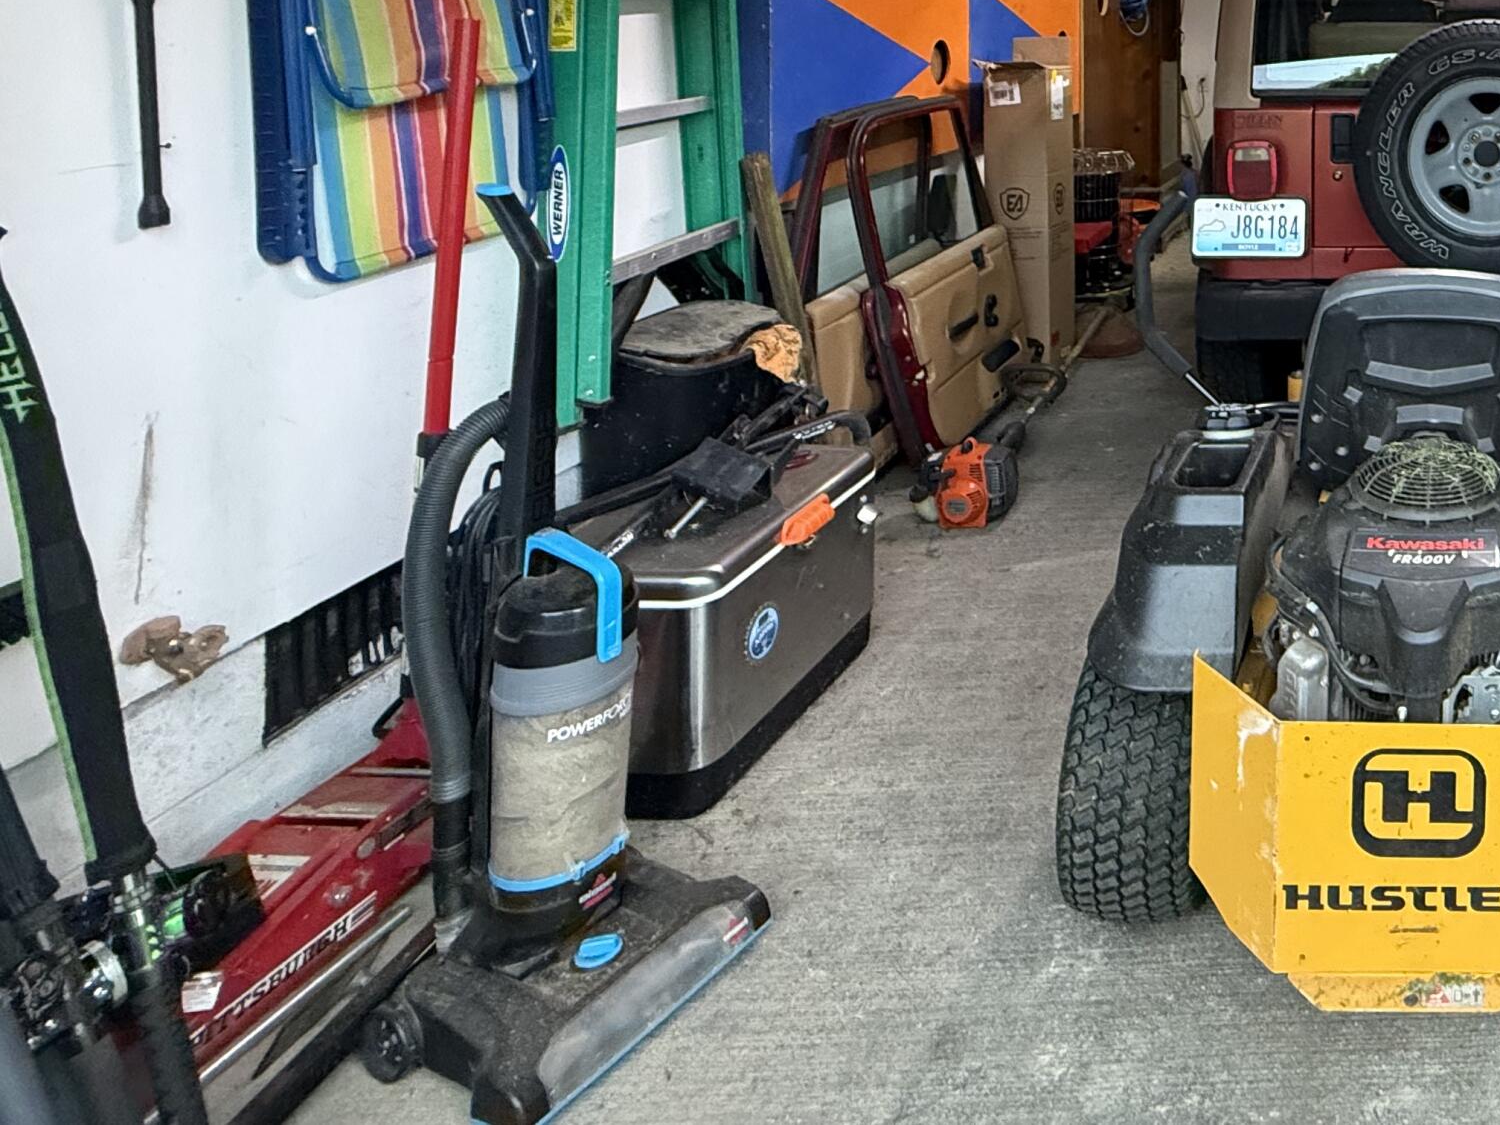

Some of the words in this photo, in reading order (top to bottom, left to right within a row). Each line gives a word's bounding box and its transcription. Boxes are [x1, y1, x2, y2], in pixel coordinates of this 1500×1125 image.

[1377, 82, 1450, 260] WRANGLER
[552, 169, 564, 236] WERNER
[1222, 203, 1278, 212] KENTUCKY
[1230, 214, 1299, 240] J8G184
[1366, 536, 1486, 551] Kawasaki
[1392, 553, 1457, 565] FR600V
